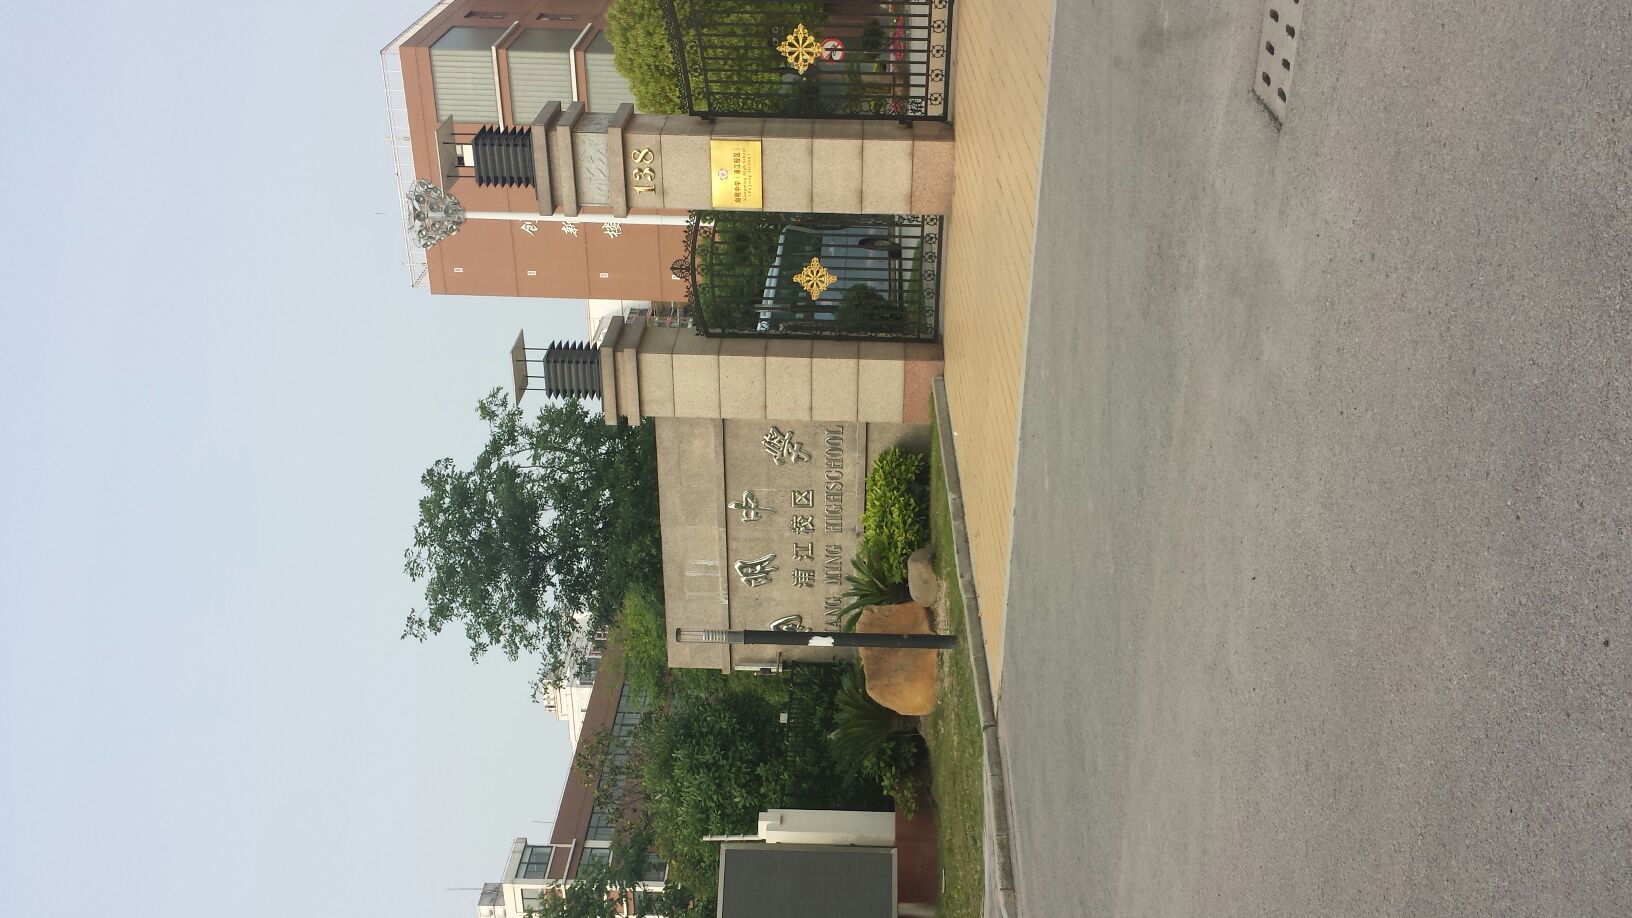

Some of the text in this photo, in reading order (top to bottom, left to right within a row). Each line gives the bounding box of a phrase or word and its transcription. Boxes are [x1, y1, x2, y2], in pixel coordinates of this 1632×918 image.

[631, 148, 656, 194] 138
[791, 489, 815, 588] 浦江校区
[824, 424, 844, 632] IANG MING HIGHSCHOOL
